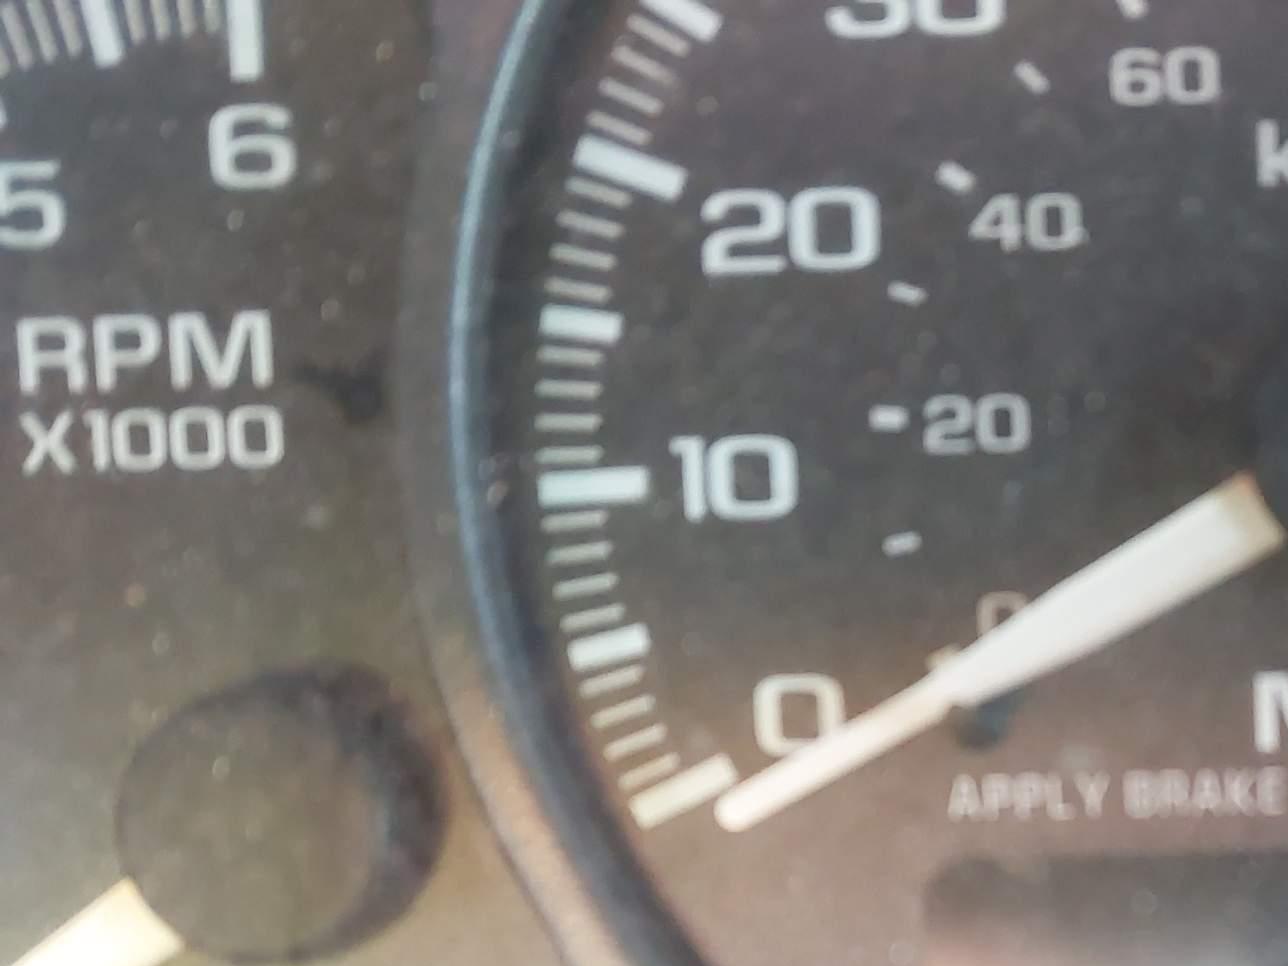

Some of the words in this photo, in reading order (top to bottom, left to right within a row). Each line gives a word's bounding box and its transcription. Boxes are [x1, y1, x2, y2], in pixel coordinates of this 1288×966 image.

[1110, 47, 1219, 105] 60
[209, 104, 295, 187] 6
[0, 162, 64, 247] 5
[703, 188, 878, 274] 20
[968, 193, 1083, 249] 40
[17, 312, 271, 393] RPM
[22, 407, 283, 472] X1000
[924, 394, 1029, 453] 20
[671, 436, 796, 519] 10
[753, 673, 844, 757] 0
[947, 772, 1109, 821] APPLY
[1123, 767, 1282, 820] BRAKE
